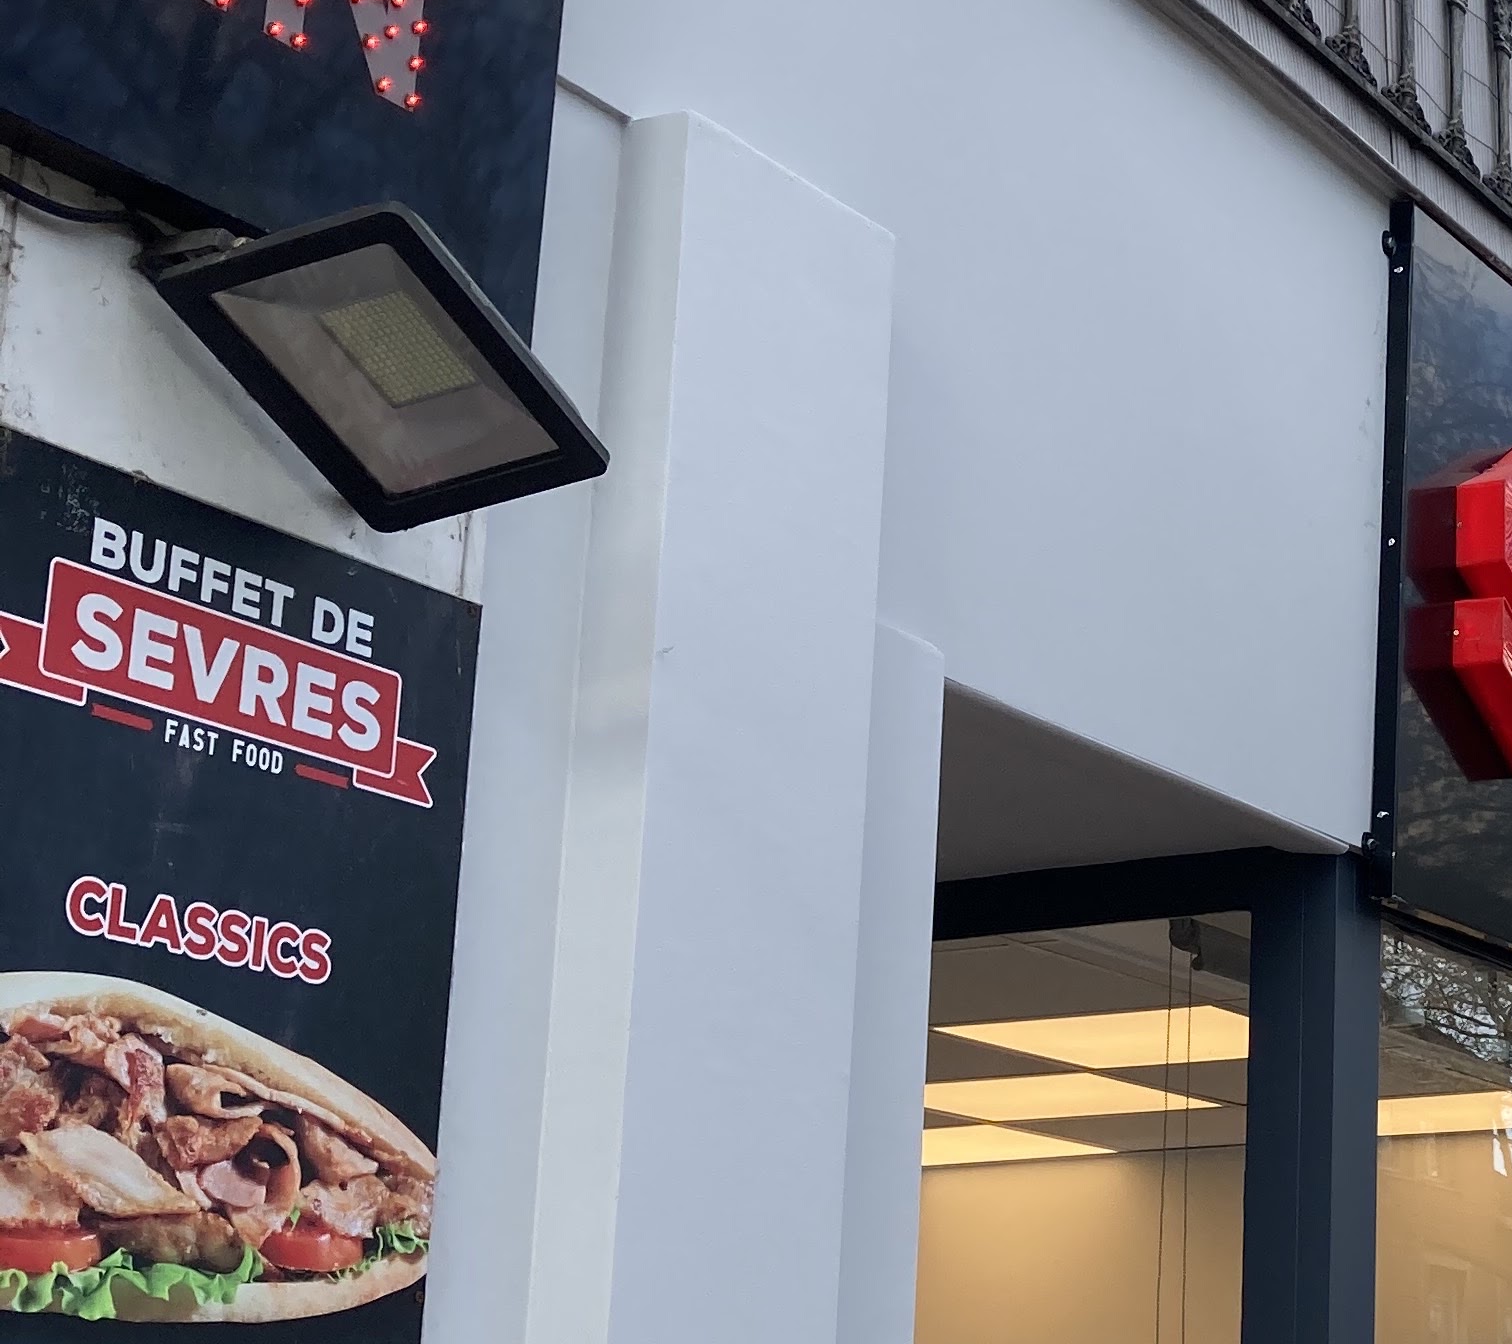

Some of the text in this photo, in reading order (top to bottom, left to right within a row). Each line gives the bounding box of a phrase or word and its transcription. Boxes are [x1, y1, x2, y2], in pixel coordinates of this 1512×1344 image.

[89, 516, 375, 659] BUFFET DE
[70, 591, 382, 754] SEVRES
[164, 718, 284, 775] FAST FOOD
[65, 874, 332, 985] CLASSICS
